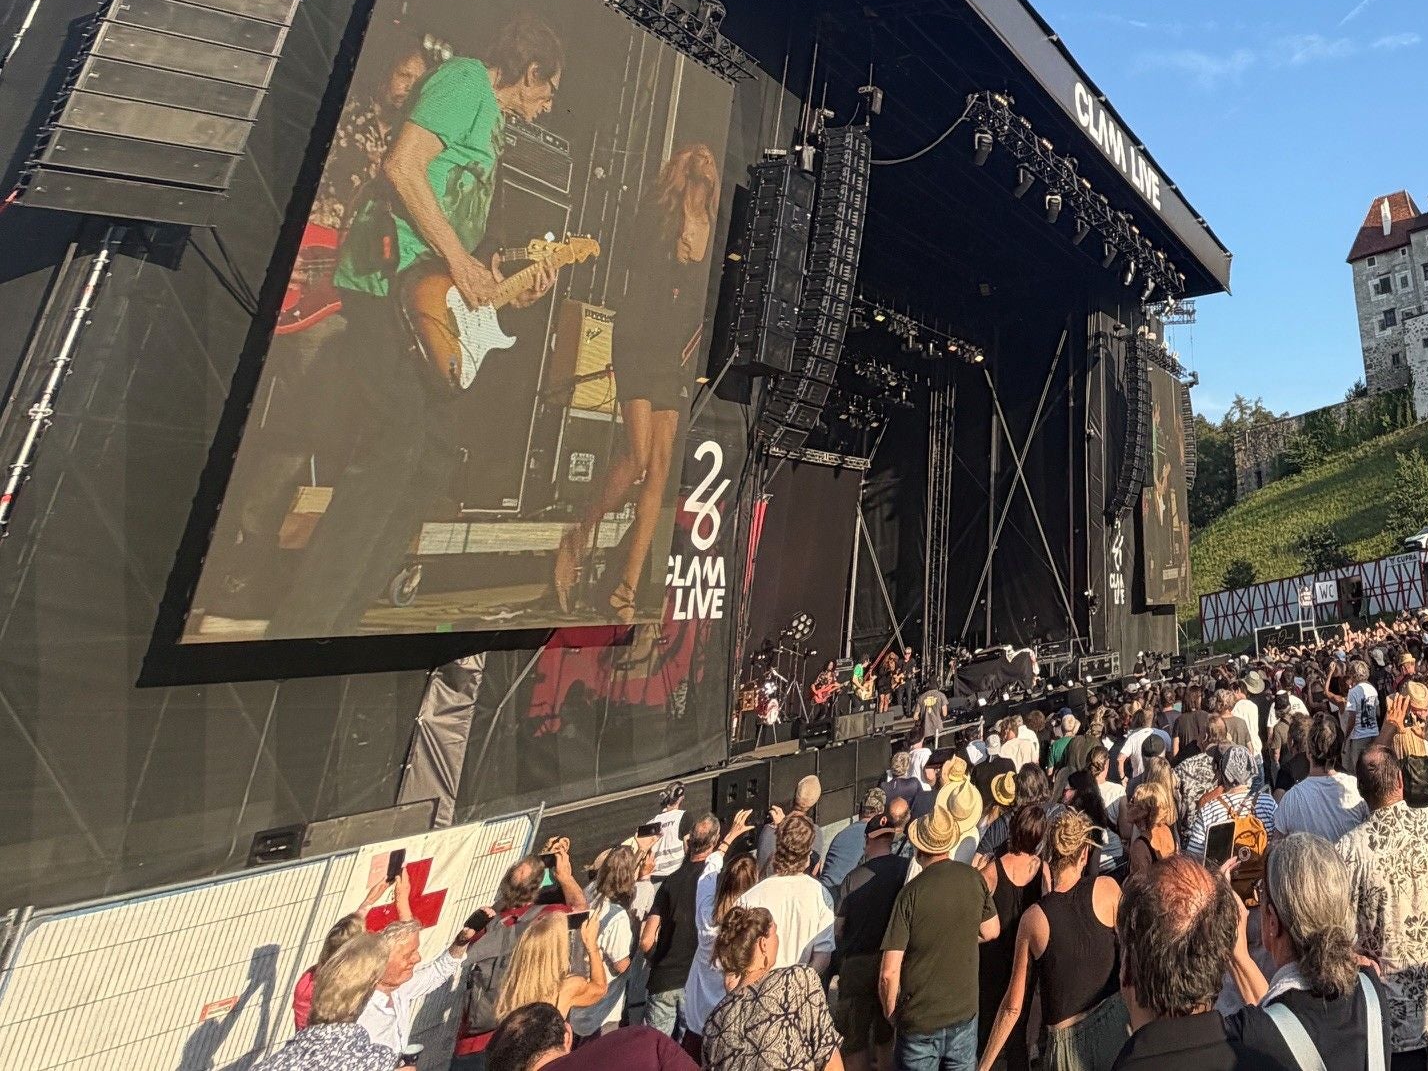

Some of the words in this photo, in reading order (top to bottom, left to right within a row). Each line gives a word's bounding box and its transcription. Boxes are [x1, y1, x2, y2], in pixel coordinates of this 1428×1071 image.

[1074, 82, 1127, 173] CLAM
[1130, 145, 1162, 211] LIVE
[1396, 553, 1417, 563] CUPRA
[1319, 584, 1335, 599] WC
[673, 588, 726, 621] LIVE
